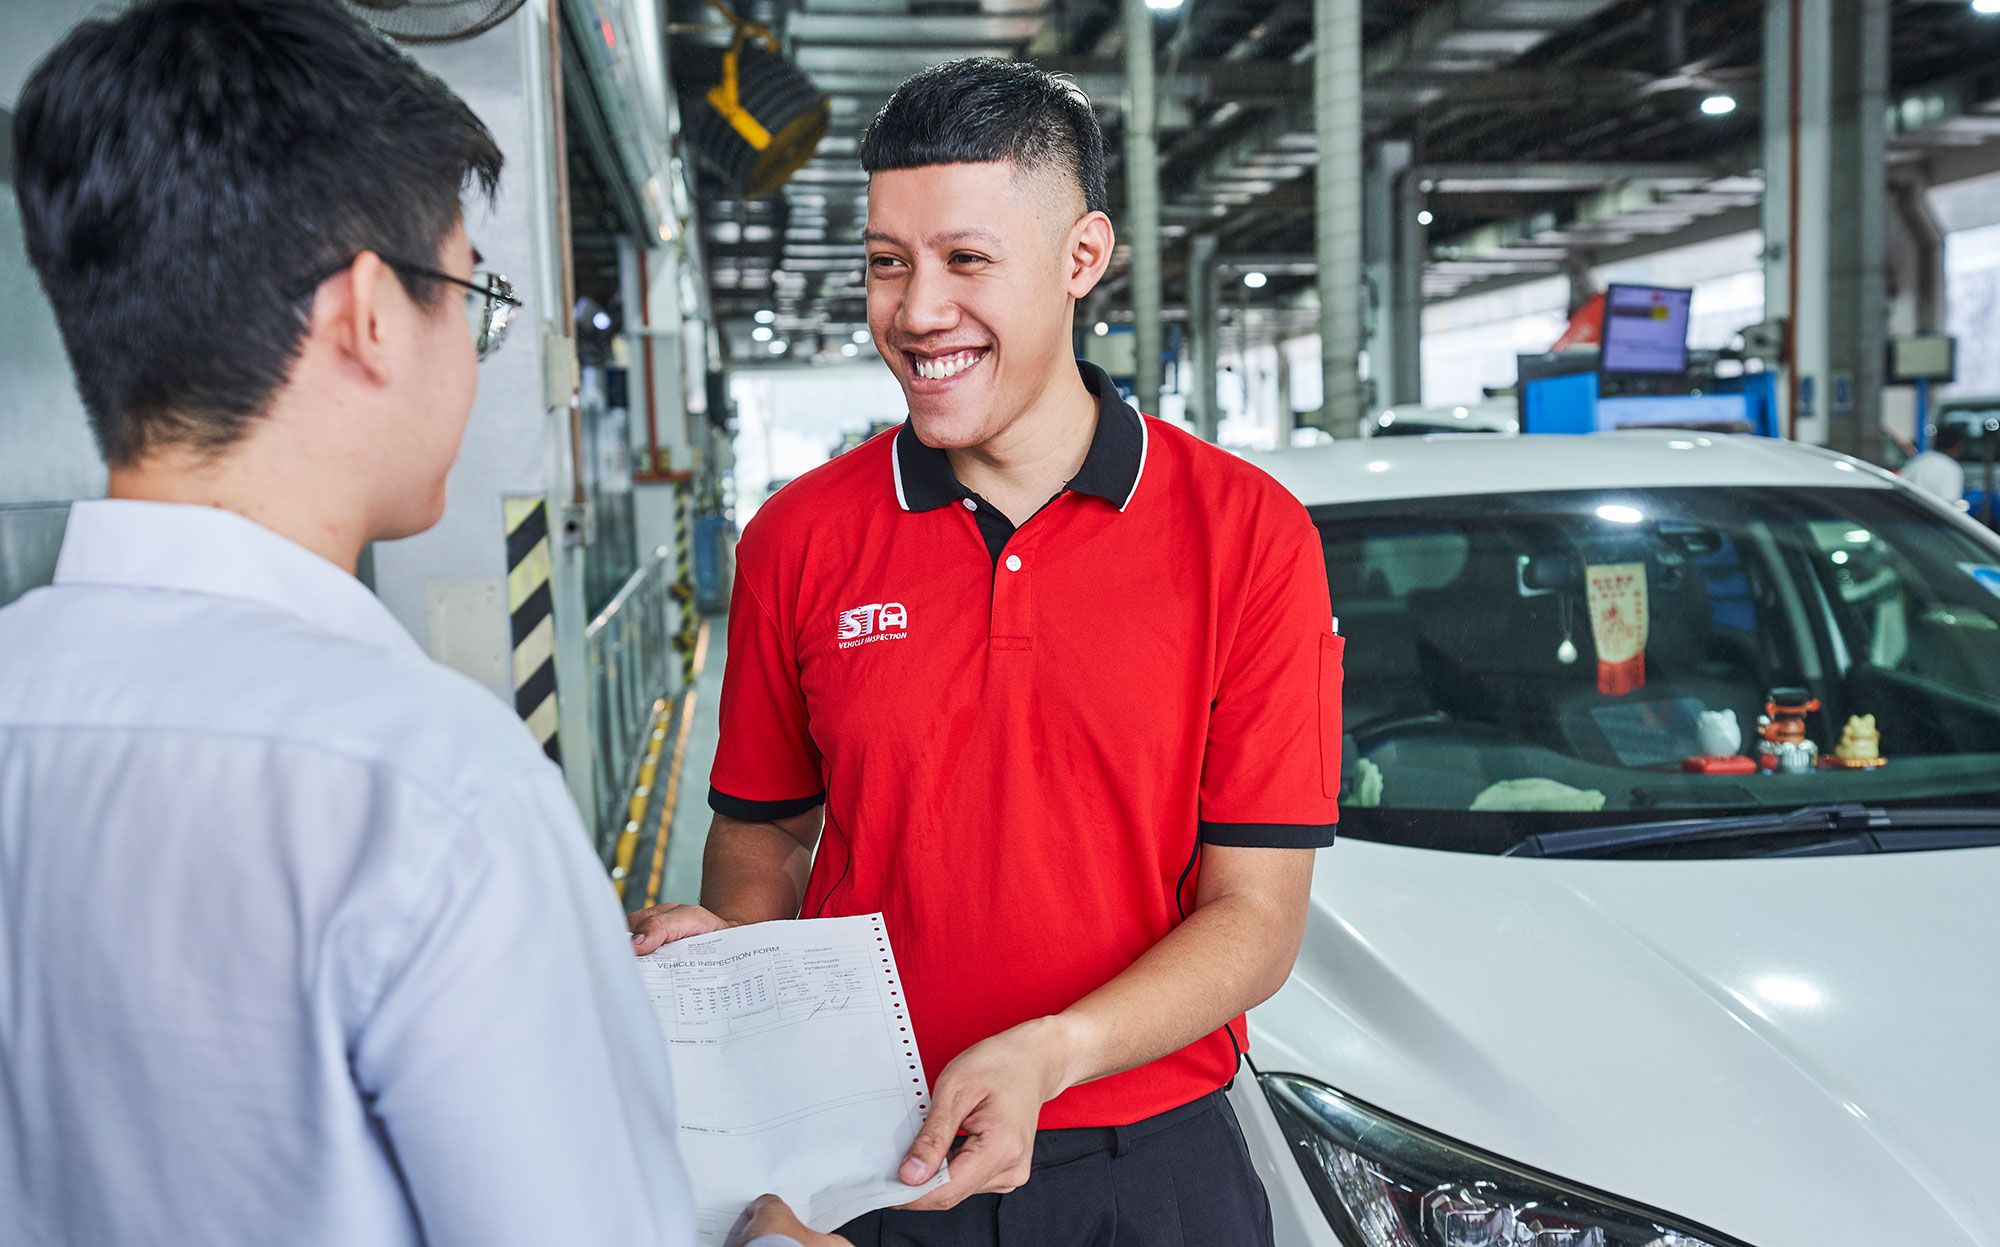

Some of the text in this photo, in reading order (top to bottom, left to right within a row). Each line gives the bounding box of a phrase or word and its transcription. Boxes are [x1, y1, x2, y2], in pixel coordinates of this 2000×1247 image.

[838, 602, 908, 639] STA
[838, 632, 908, 649] VEHICLE INSPECTION
[657, 960, 696, 969] VEHICLE
[698, 951, 752, 967] INSPECTION
[753, 946, 780, 957] FORM
